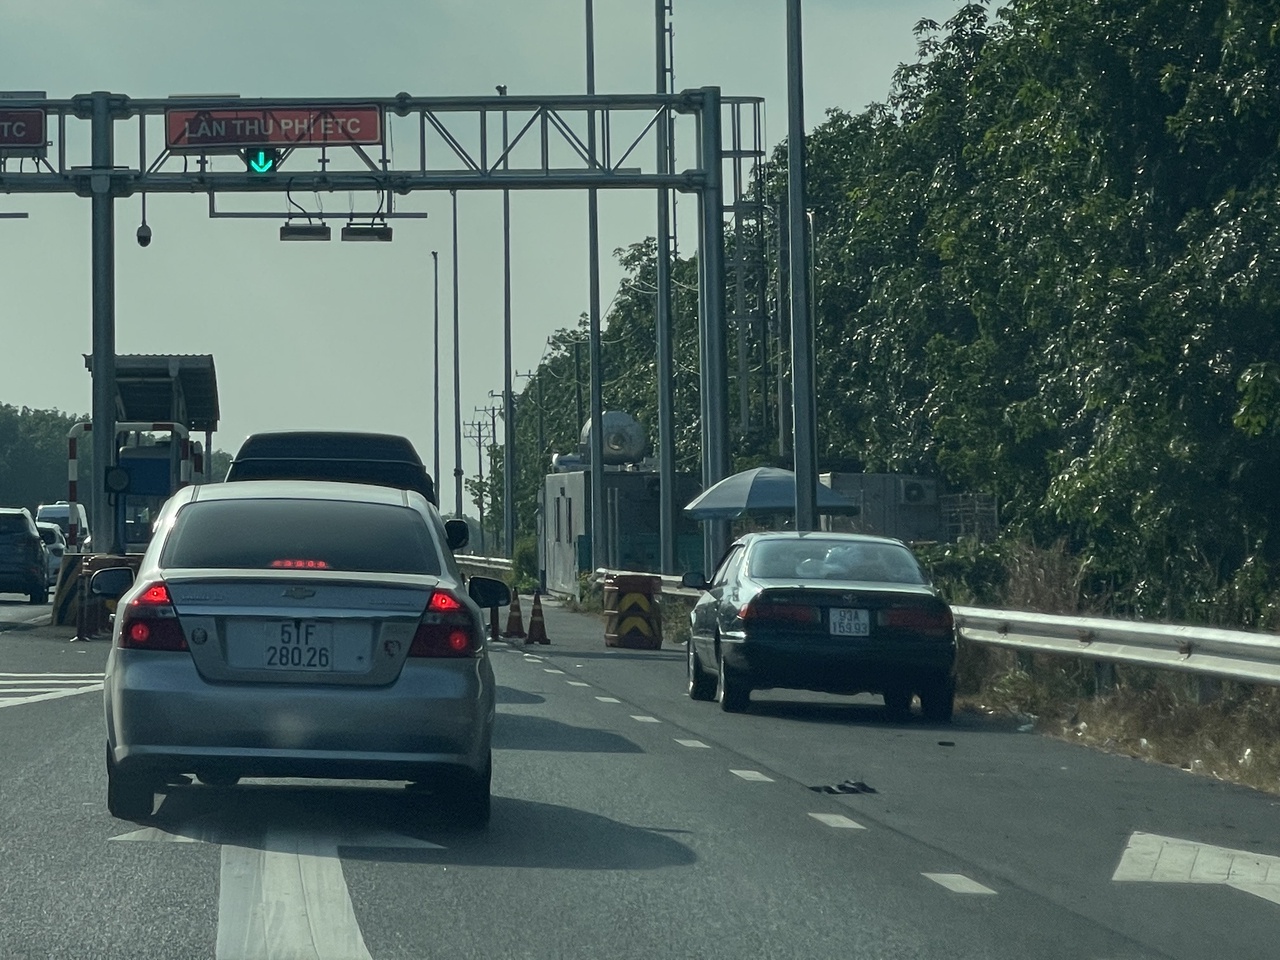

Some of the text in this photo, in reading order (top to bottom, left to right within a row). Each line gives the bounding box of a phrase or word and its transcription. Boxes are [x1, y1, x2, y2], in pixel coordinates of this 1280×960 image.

[185, 114, 361, 138] LÀN THU PHÍ ETC
[281, 623, 316, 645] 51F
[267, 645, 329, 667] 280.26
